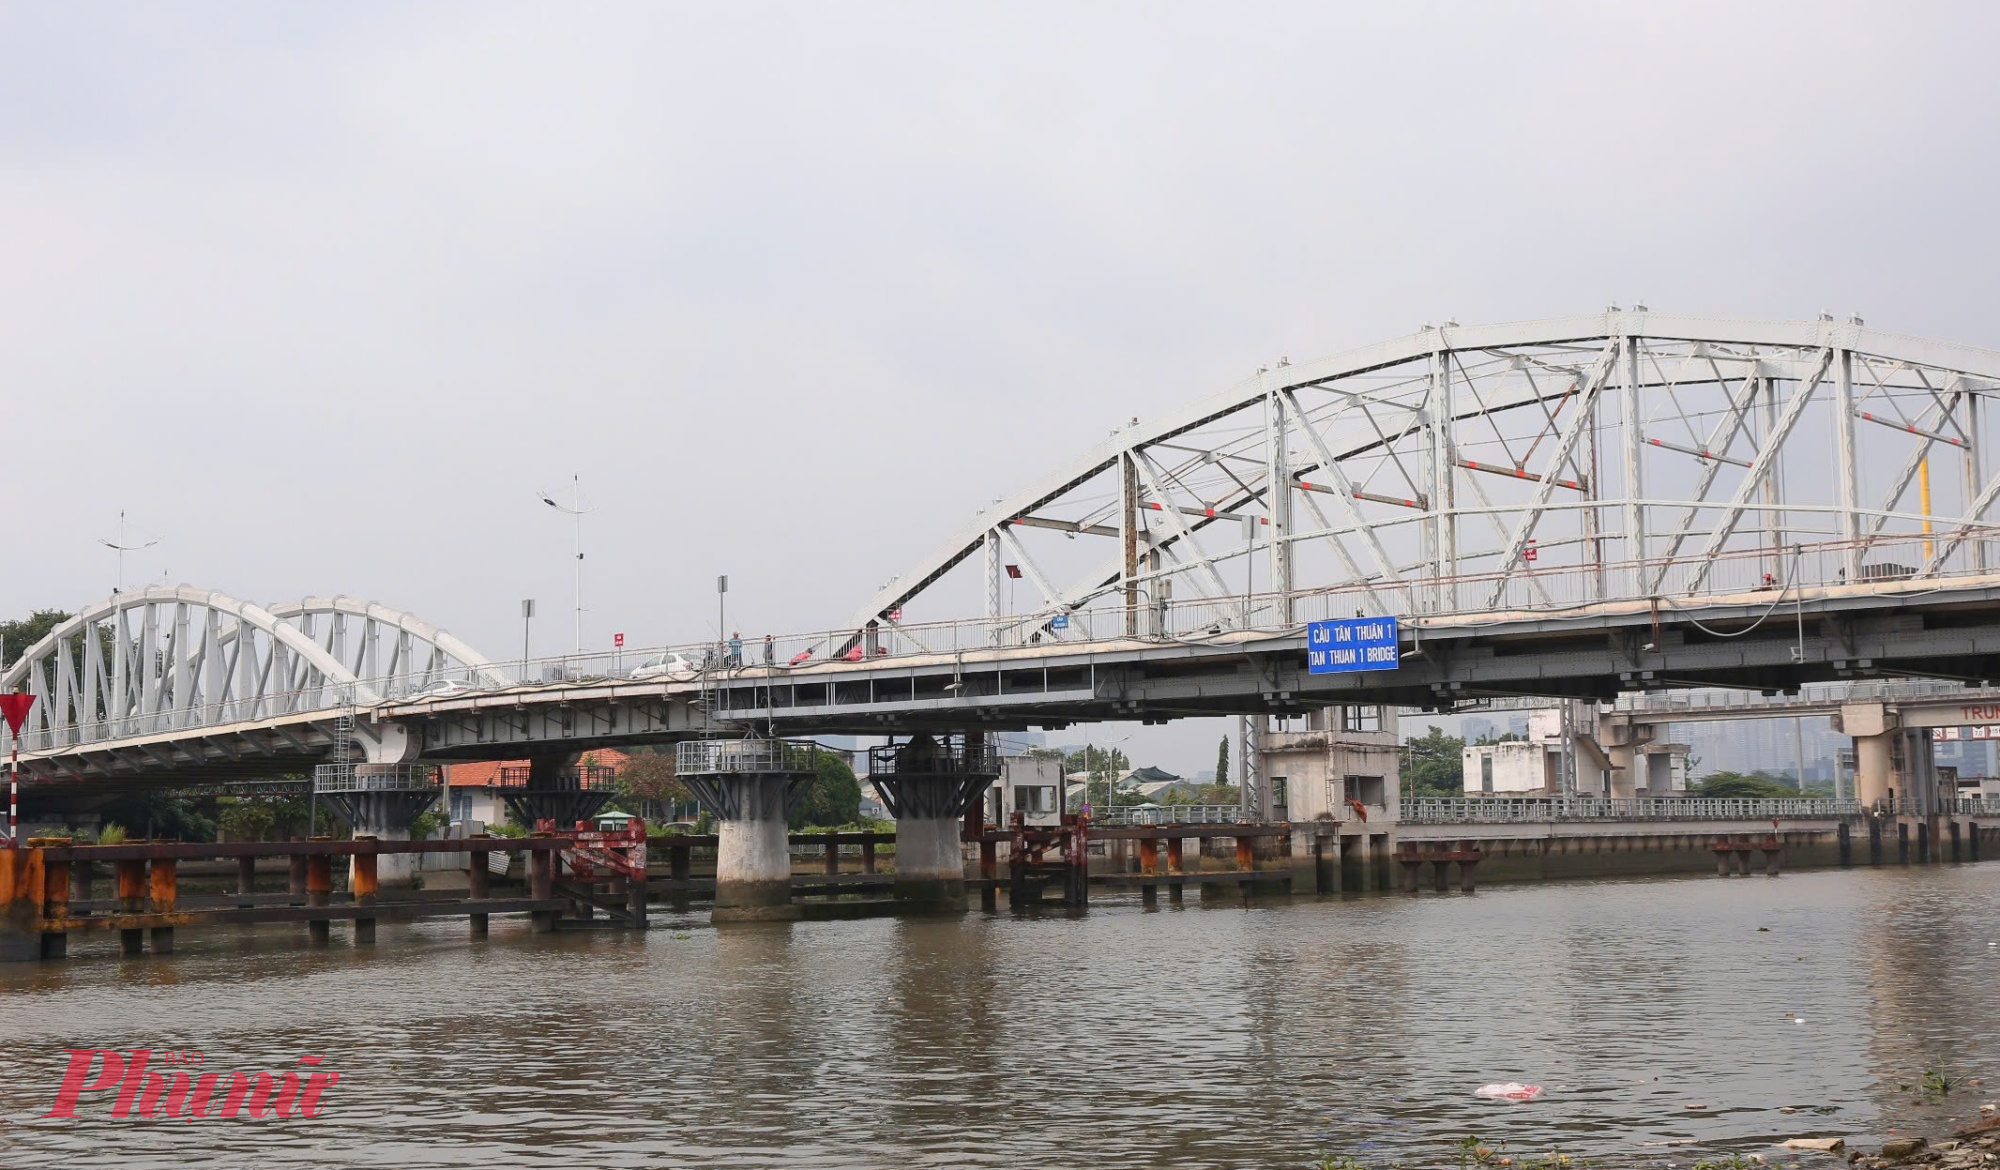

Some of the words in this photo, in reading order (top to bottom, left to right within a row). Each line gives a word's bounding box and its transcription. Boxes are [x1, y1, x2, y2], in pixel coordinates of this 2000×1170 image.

[1314, 623, 1330, 643] CẦU
[1335, 625, 1351, 643] TÂN
[1356, 623, 1383, 643] THUẬN
[1387, 624, 1392, 639] 1
[1310, 651, 1326, 666] TAN
[1329, 649, 1356, 665] THUAN
[1359, 648, 1364, 663] 1
[1367, 646, 1396, 662] BRIDGE
